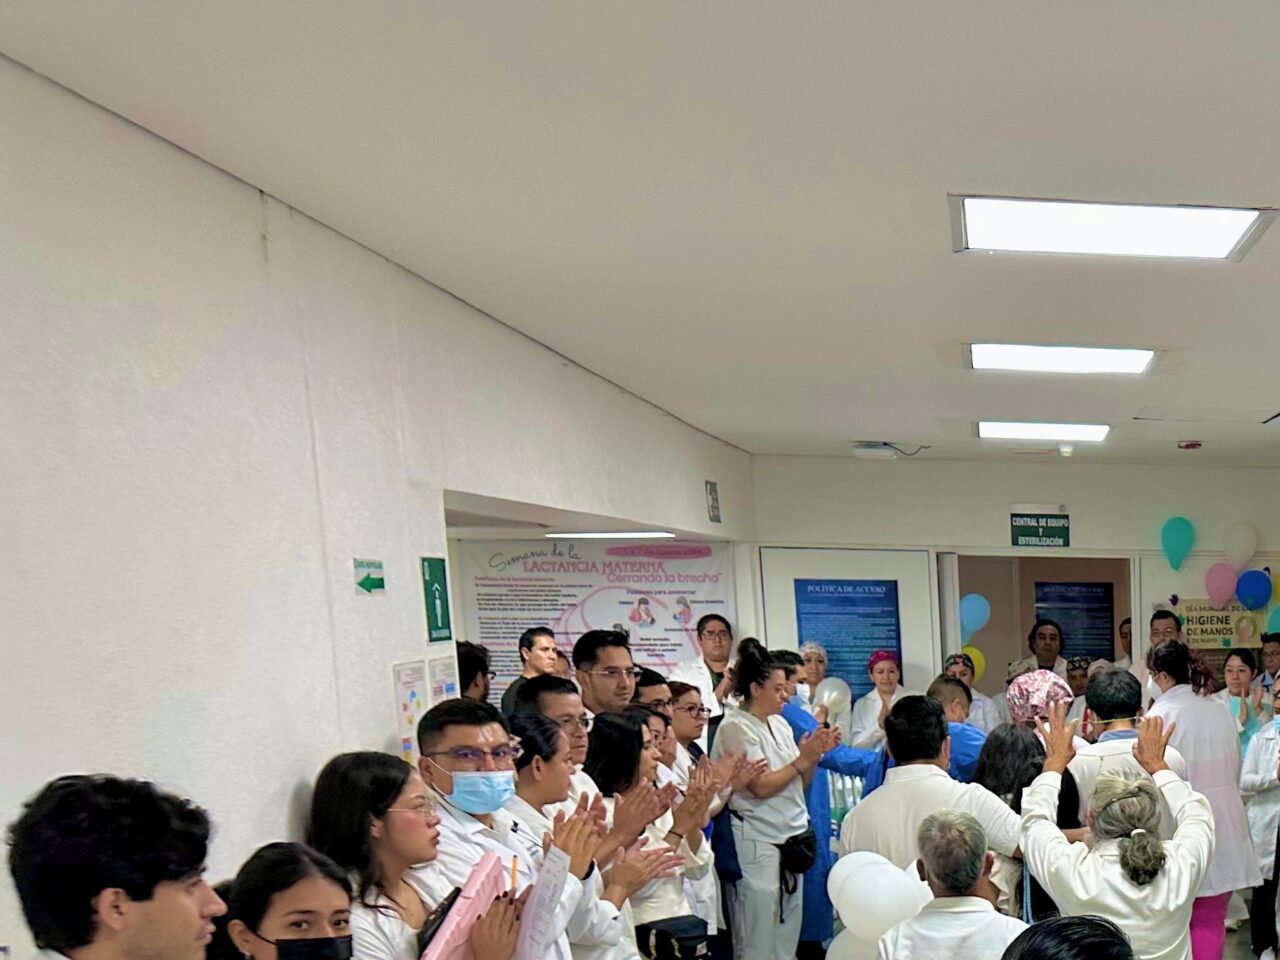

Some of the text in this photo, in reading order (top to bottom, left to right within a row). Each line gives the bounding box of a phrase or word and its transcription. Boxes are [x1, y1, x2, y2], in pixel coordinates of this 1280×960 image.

[1012, 516, 1069, 528] CENTRAL DE EQUIPO
[1038, 527, 1044, 537] Y
[488, 542, 582, 573] Semana de la
[523, 560, 665, 573] LACTANCIA MATERNA
[665, 571, 676, 583] la
[807, 583, 886, 593] POLÍTICA DE ACCESO
[1186, 615, 1231, 626] HIGIENE
[1186, 627, 1233, 636] DE MANOS
